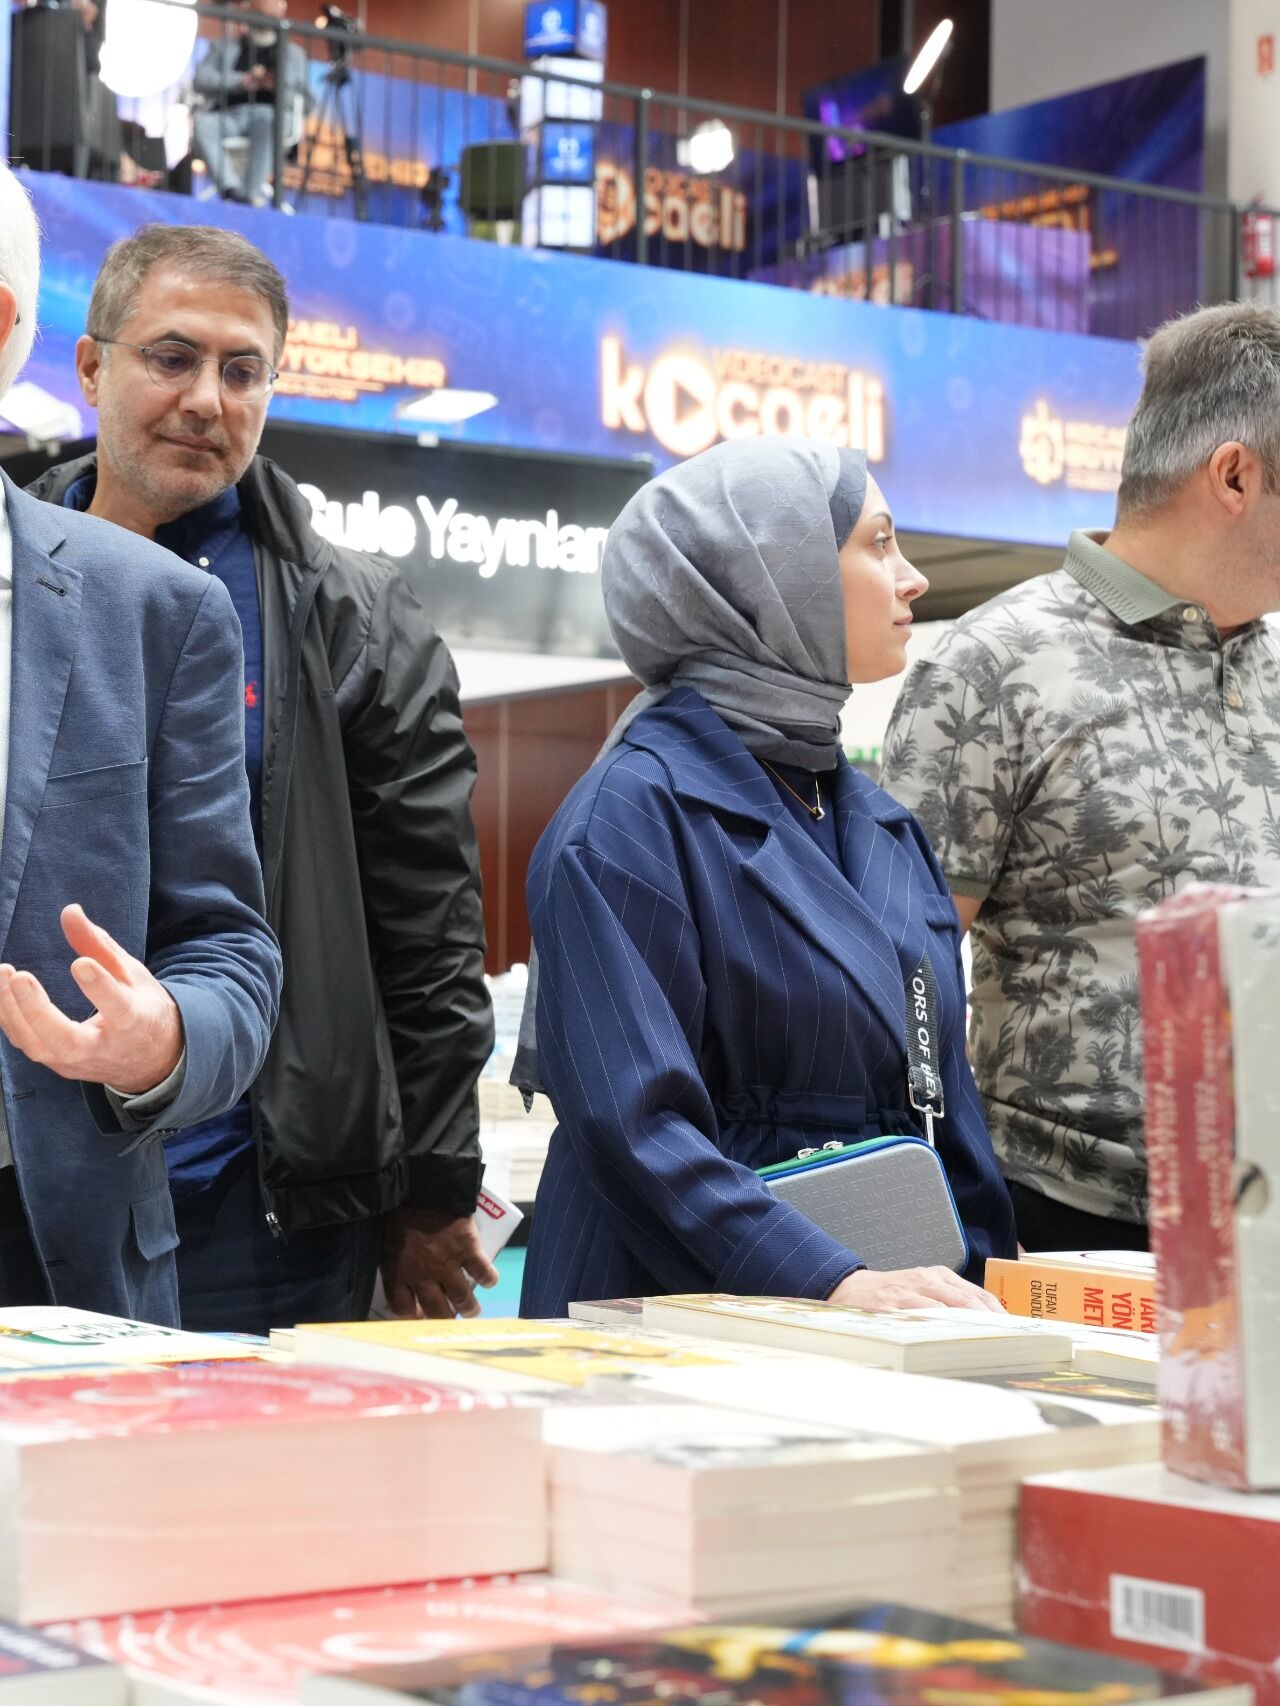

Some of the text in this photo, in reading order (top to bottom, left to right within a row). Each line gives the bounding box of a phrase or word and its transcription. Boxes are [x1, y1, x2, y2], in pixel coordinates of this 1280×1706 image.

[912, 967, 928, 1023] ORS
[917, 1027, 931, 1060] OF
[1030, 1279, 1044, 1319] GÜNDÜ
[1045, 1282, 1058, 1315] TUFAN
[1111, 1291, 1136, 1331] YÖN
